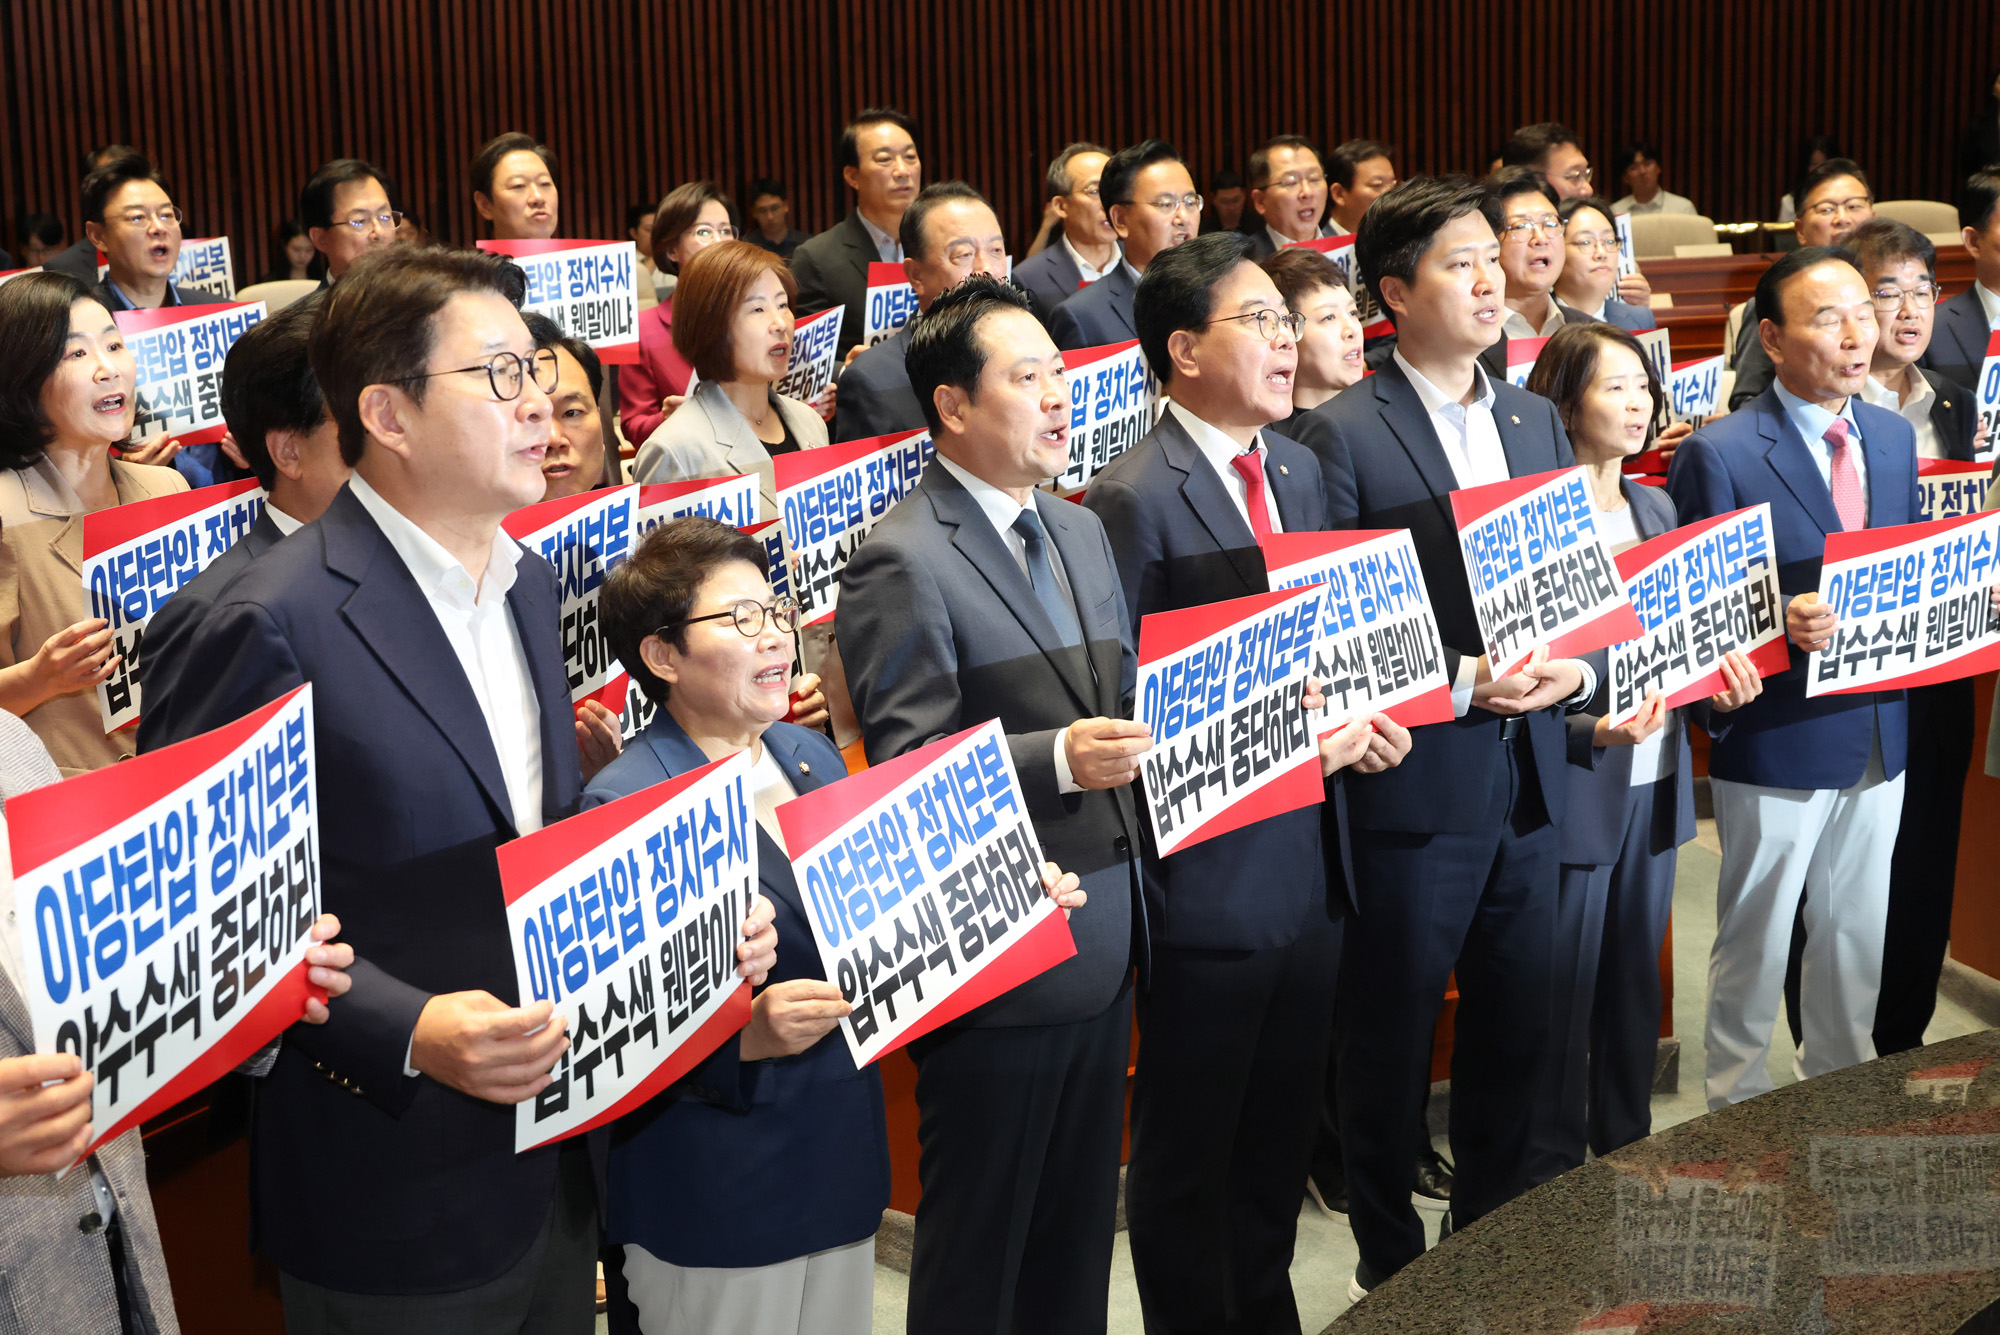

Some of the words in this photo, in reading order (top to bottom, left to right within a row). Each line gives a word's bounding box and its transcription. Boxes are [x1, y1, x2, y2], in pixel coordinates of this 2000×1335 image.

[525, 261, 562, 304] 탄압
[567, 252, 630, 298] 정치수사
[571, 296, 632, 341] 웬말이냐
[871, 288, 919, 329] 야당
[124, 329, 188, 387] 당탄압
[132, 379, 195, 437] 수수색
[1673, 367, 1717, 415] 치수사
[784, 467, 864, 551] 야당탄압
[1464, 510, 1523, 597] 야당탄압
[1520, 477, 1597, 564] 정치보복
[1941, 478, 1992, 518] 정치
[1349, 545, 1423, 623] 정치수사
[1479, 577, 1537, 667] 압수수색
[1532, 541, 1619, 631] 중단하라
[1614, 558, 1681, 648] 당탄압
[1683, 513, 1769, 605] 정치보복
[1828, 551, 1925, 621] 야당탄압
[1143, 636, 1233, 745] 야당탄압
[1233, 595, 1321, 703] 정치보복
[1313, 636, 1372, 717] 수수색
[1367, 613, 1440, 696] 웬말이냐
[1615, 619, 1691, 715] 압수수색
[1690, 574, 1777, 667] 중단하라
[1818, 611, 1919, 682] 압수수색
[1146, 719, 1227, 839] 압수수색
[1231, 675, 1310, 788] 중단하라
[35, 799, 198, 1004] 야당탄압
[207, 706, 310, 896] 정치보복
[524, 849, 646, 1003] 야당탄압
[646, 775, 748, 929] 정치수사
[806, 803, 926, 948] 야당탄압
[906, 734, 1019, 872] 정치보복
[211, 826, 318, 1023] 중단하라
[837, 892, 957, 1047] 압수수색
[940, 821, 1049, 963] 중단하라
